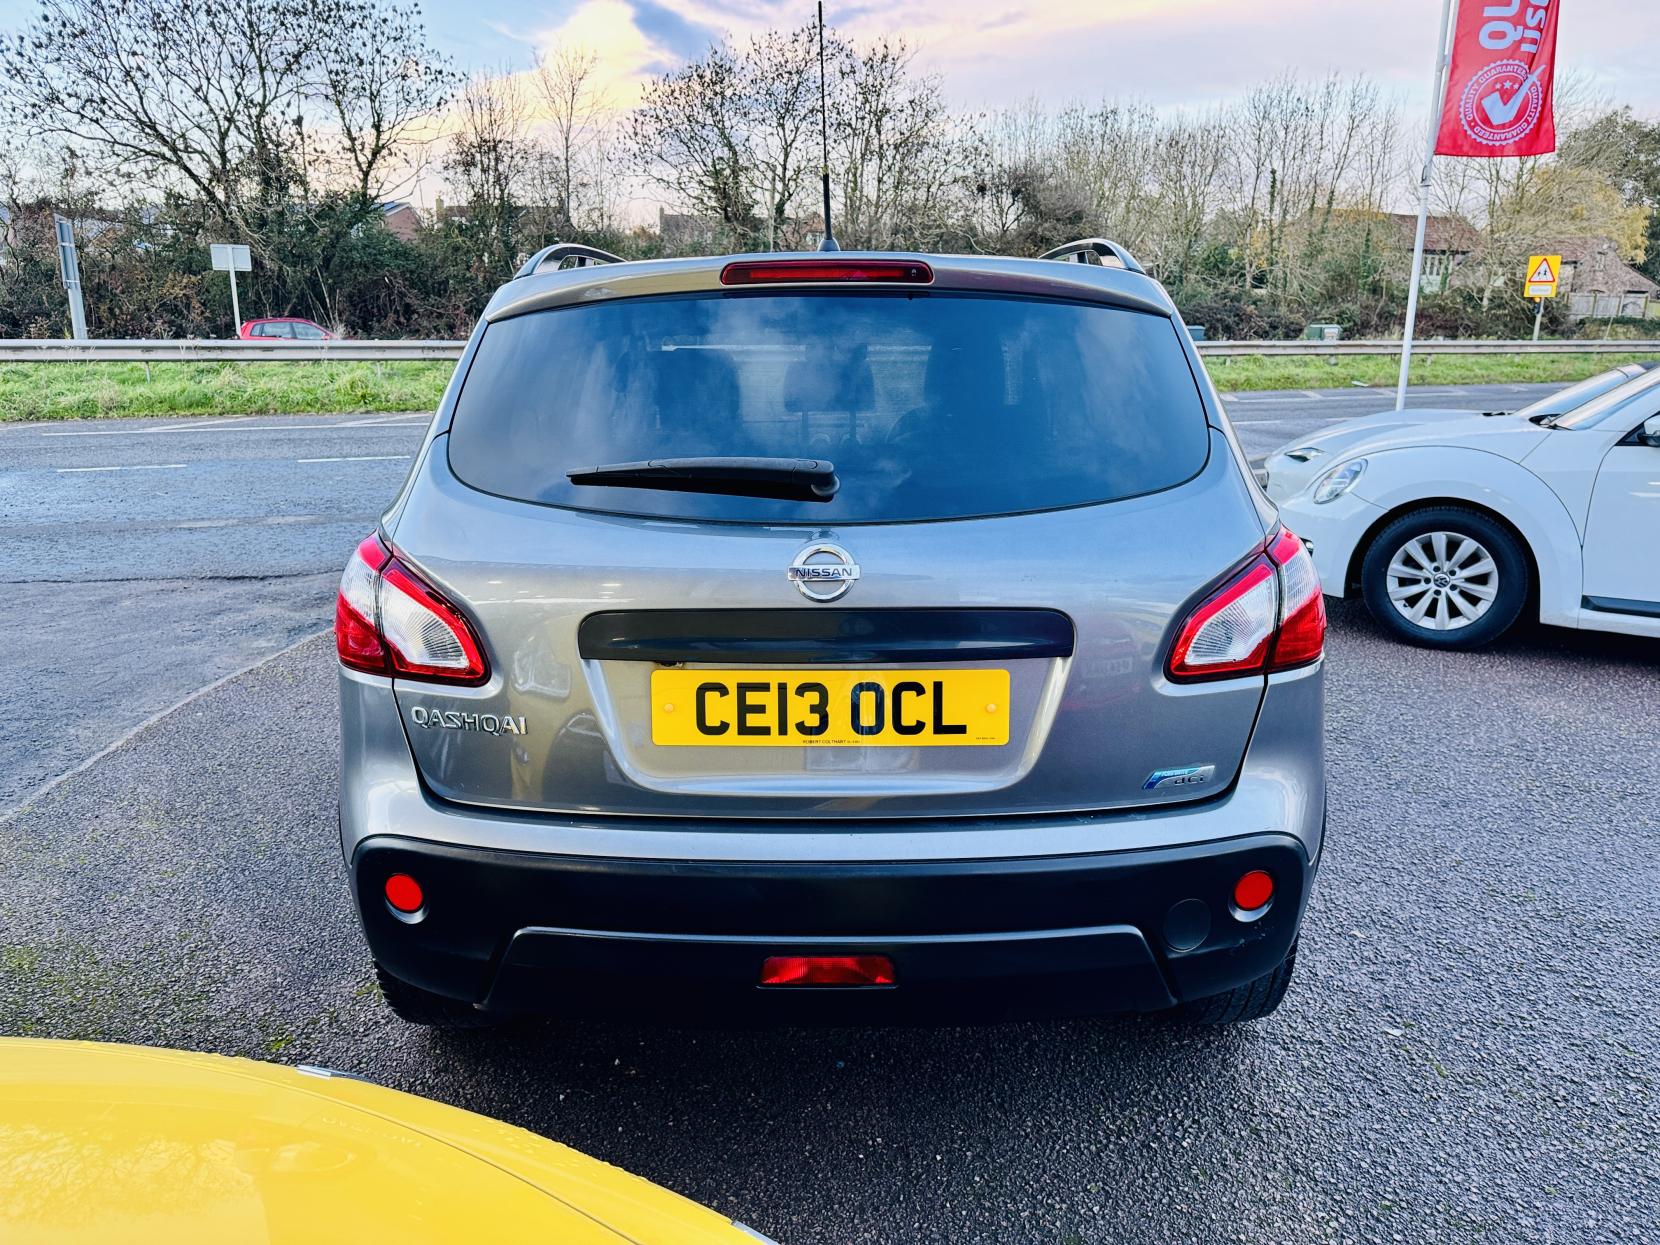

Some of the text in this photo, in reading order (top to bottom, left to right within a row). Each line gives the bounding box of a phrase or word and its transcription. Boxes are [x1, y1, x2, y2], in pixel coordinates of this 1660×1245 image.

[1464, 83, 1479, 121] QUALITY
[1474, 86, 1538, 141] QUALITY GUARANTEED
[795, 568, 853, 577] NISSAN
[411, 706, 528, 736] QASHQAI
[696, 681, 967, 736] CE13 OCL
